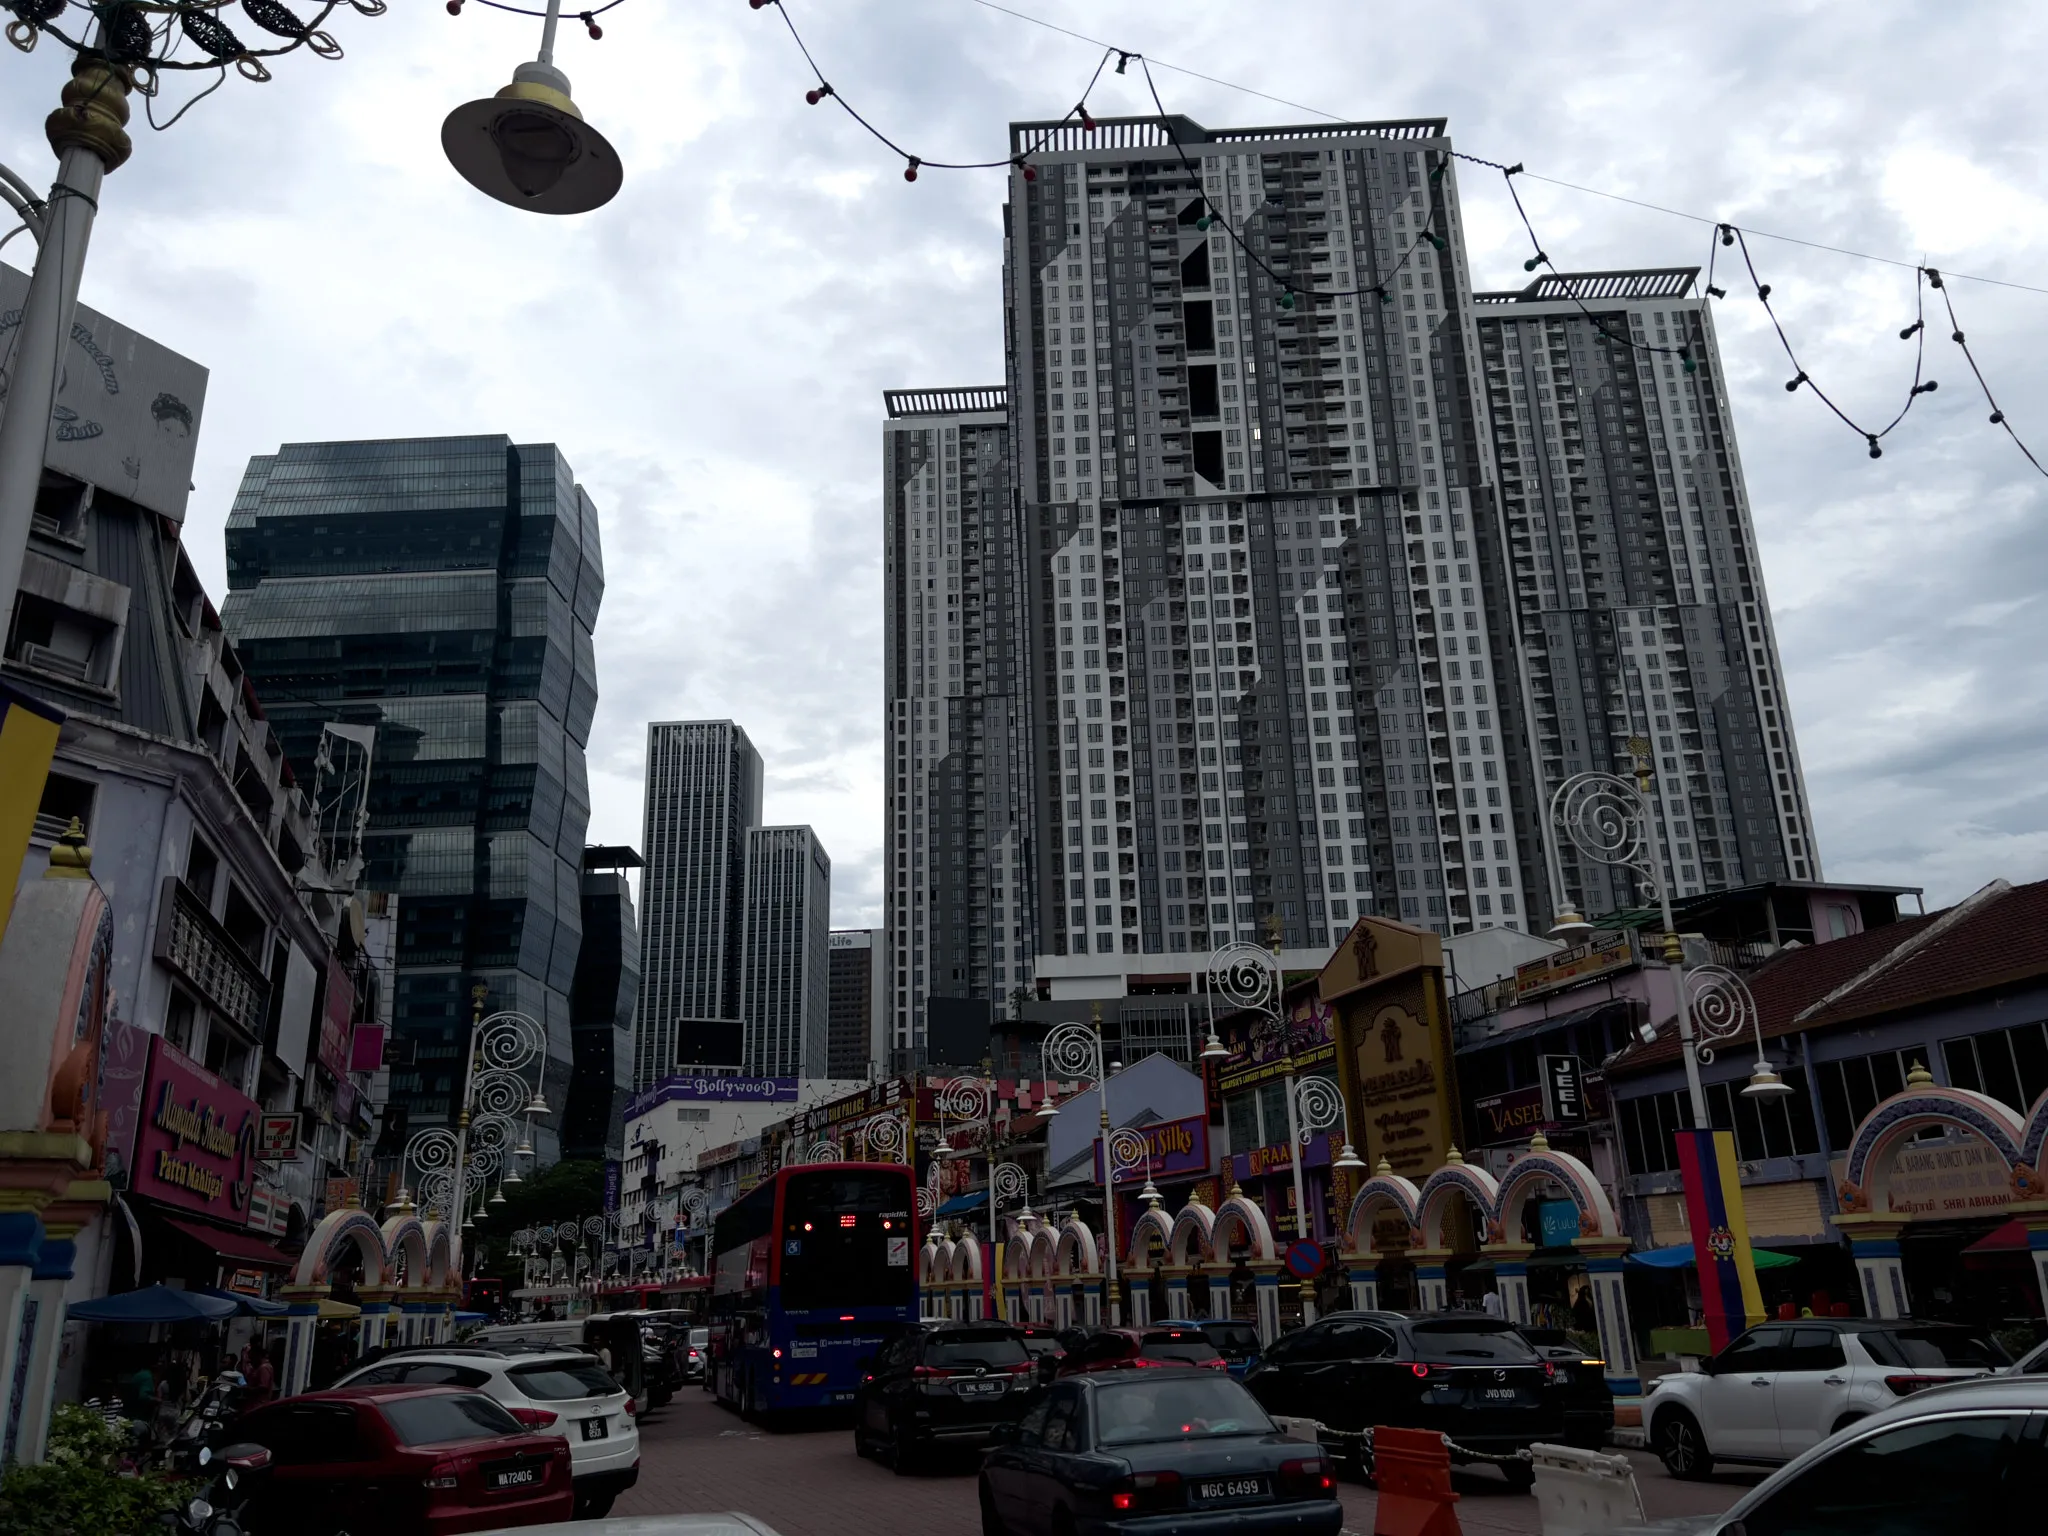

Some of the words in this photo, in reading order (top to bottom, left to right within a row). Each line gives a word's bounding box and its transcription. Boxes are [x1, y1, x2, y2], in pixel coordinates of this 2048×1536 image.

[1596, 935, 1618, 947] MONEY
[1318, 1047, 1334, 1061] OUTLET
[1555, 1060, 1579, 1117] JEEL
[829, 1106, 841, 1124] SILK
[841, 1097, 865, 1118] PALACE
[1159, 1126, 1192, 1156] Silks
[1262, 1143, 1304, 1165] RAAI
[1906, 1154, 1935, 1172] BARANG
[1936, 1150, 1964, 1169] RUNCIT
[1965, 1148, 1983, 1166] DAN
[1944, 1198, 1966, 1211] SHRI
[1969, 1193, 2011, 1208] ABIRAMI
[1200, 1483, 1225, 1498] WGC
[1227, 1479, 1259, 1496] 6499
